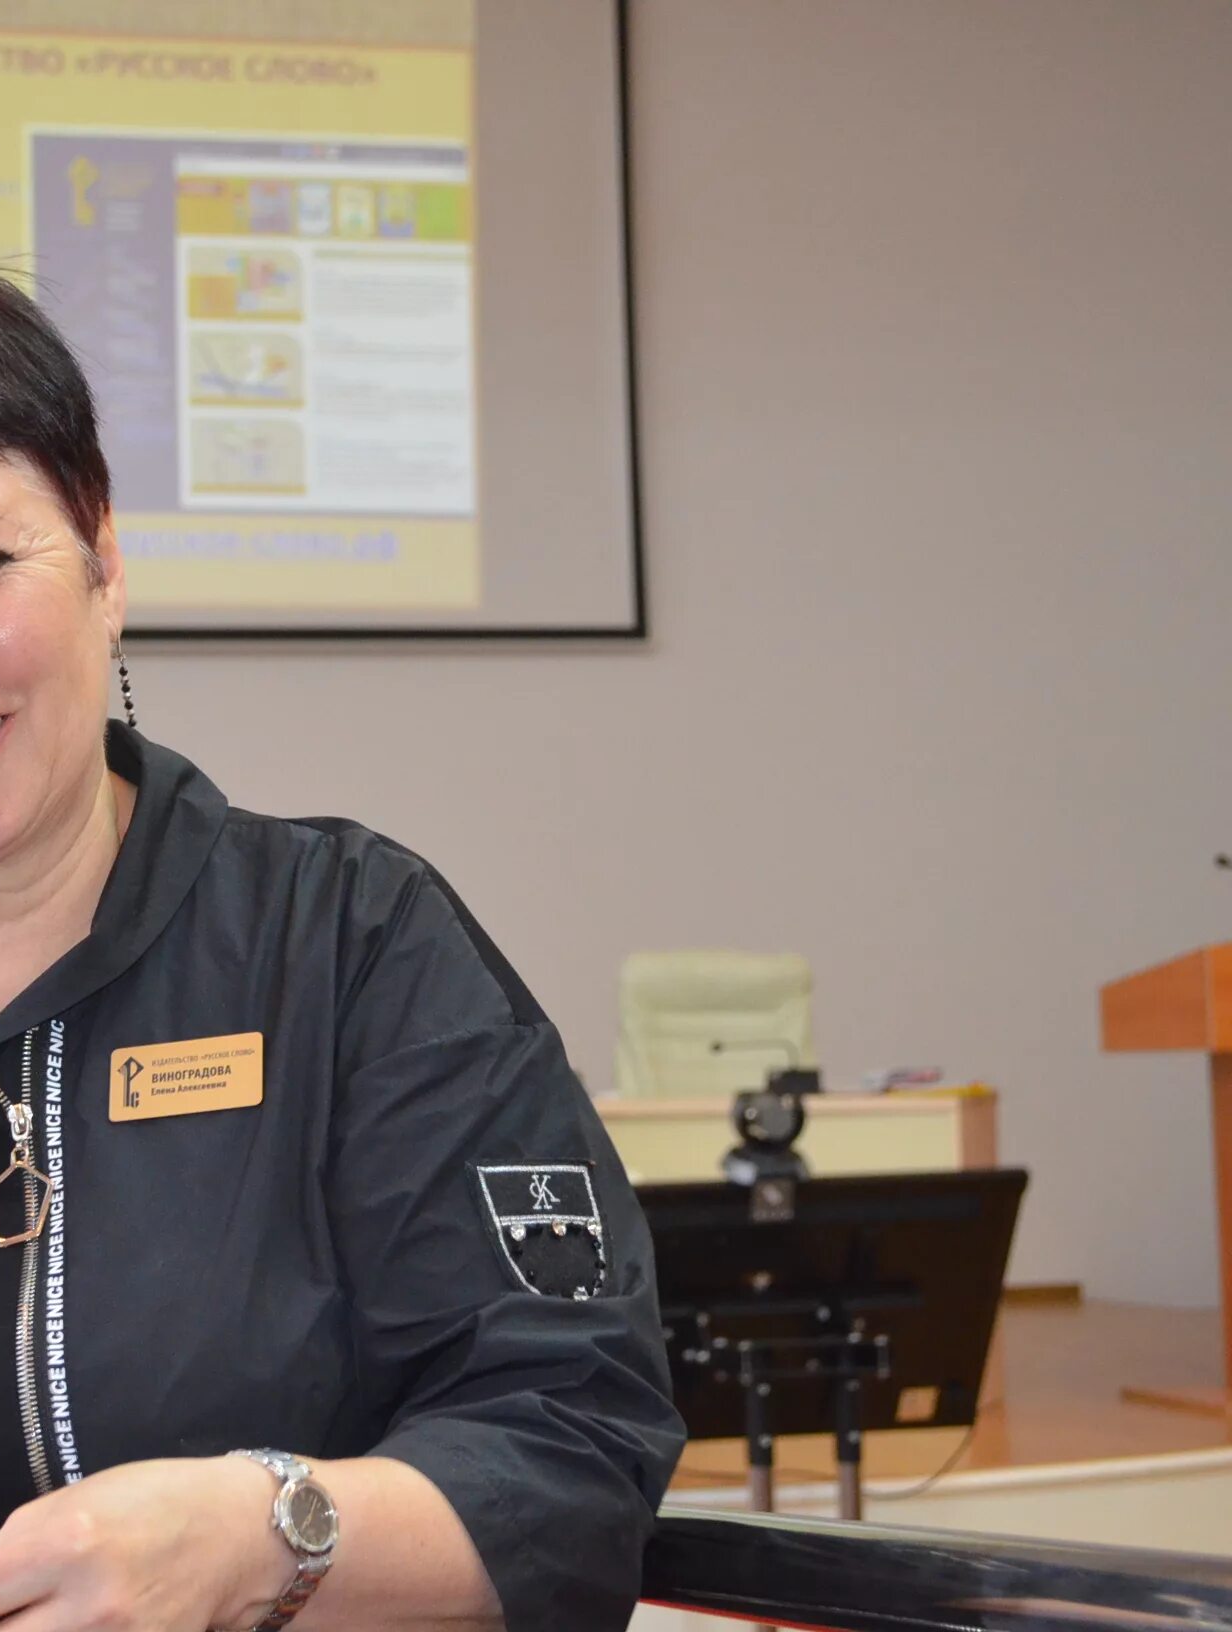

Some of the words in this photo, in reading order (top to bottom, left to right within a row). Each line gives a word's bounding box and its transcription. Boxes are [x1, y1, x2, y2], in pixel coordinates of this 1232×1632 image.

[75, 48, 235, 81] «РУССКОЕ
[245, 53, 380, 85] СЛОВО»
[151, 1056, 199, 1067] ИЗДАТЕЛЬСТВО
[152, 1065, 232, 1083] ВИНОГРАДОВА
[151, 1086, 176, 1096] Елена
[177, 1081, 227, 1093] Алексеевна
